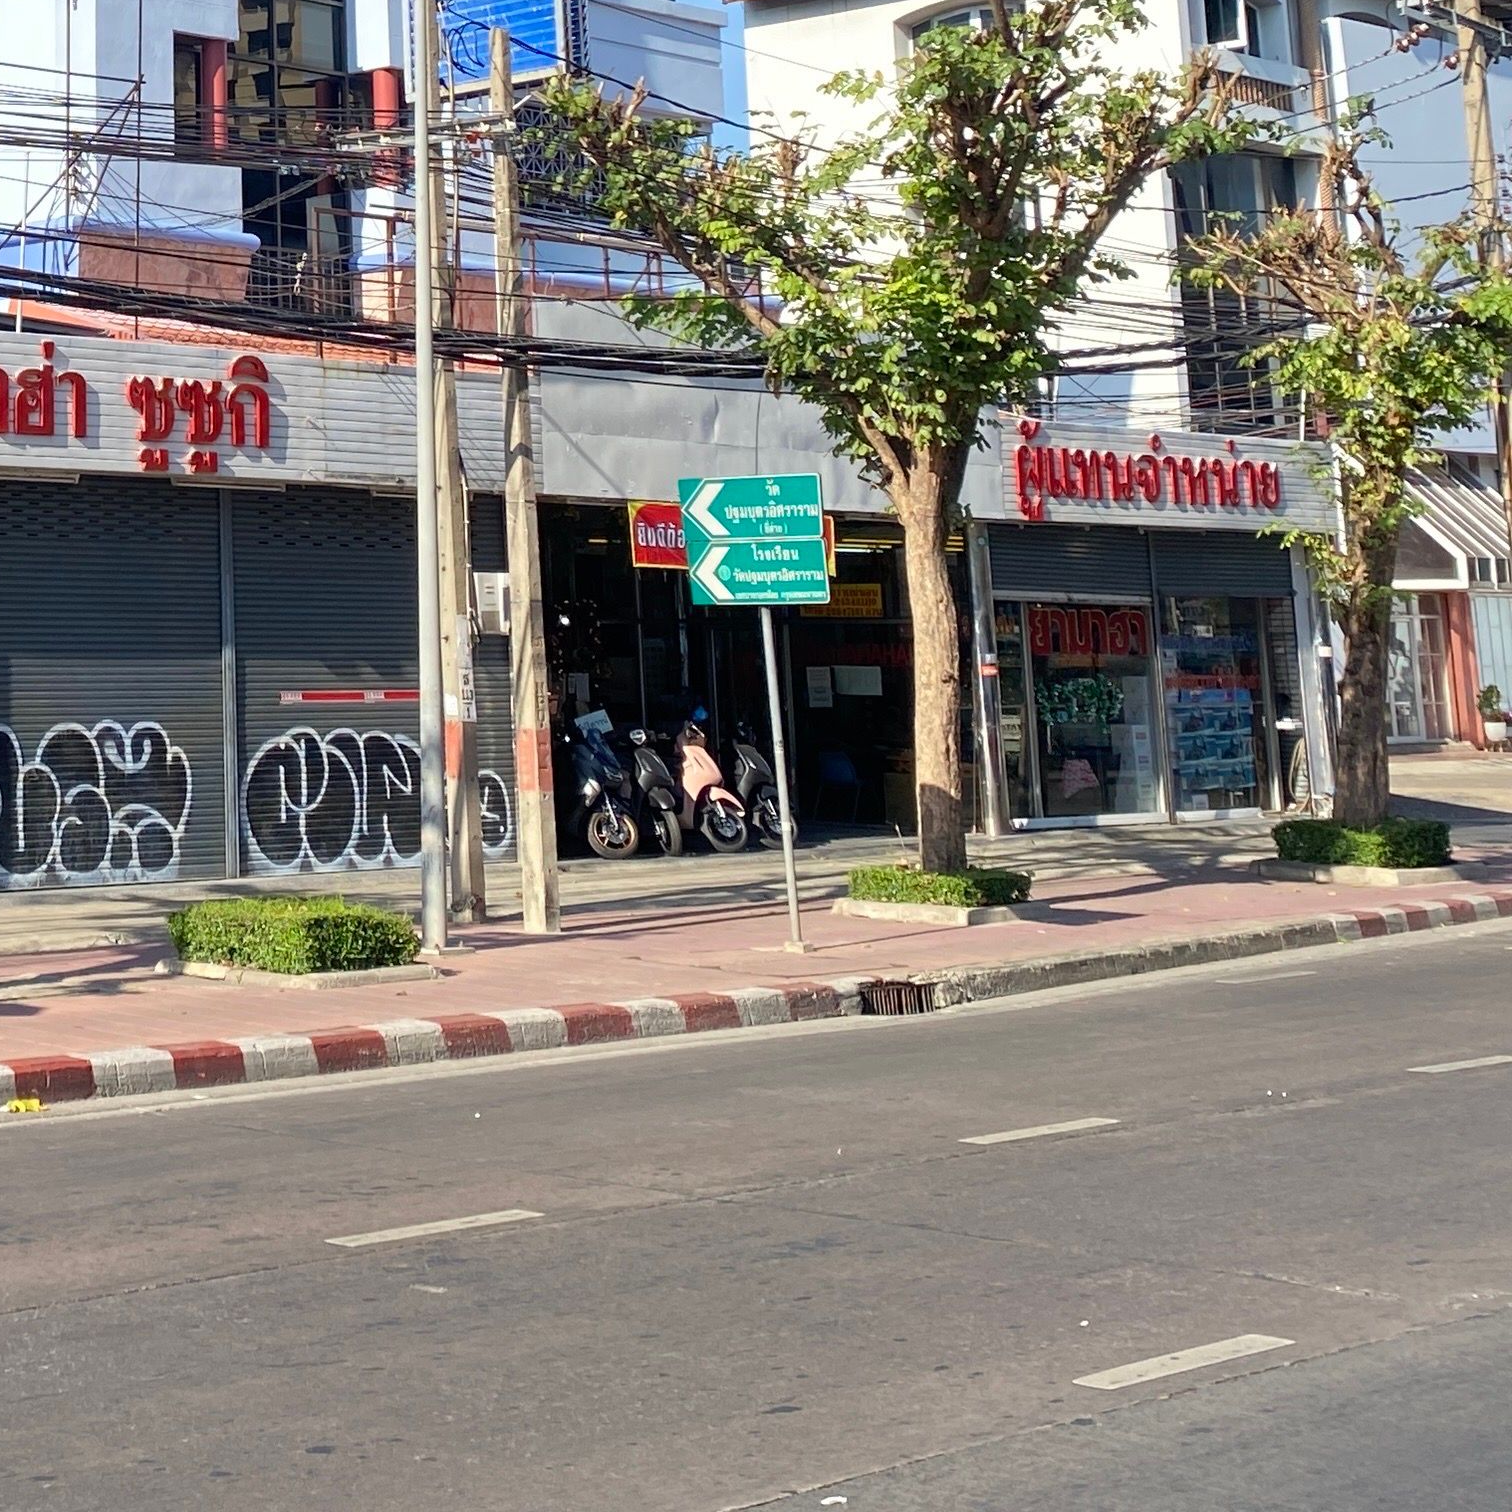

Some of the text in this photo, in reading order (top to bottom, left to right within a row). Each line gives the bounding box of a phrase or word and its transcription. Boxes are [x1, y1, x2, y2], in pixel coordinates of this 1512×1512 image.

[126, 354, 270, 473] ซูซูกิ
[765, 478, 780, 496] วัด
[1015, 419, 1281, 521] ผู้แทนจำหน่าย
[751, 543, 800, 561] โรงเรียน
